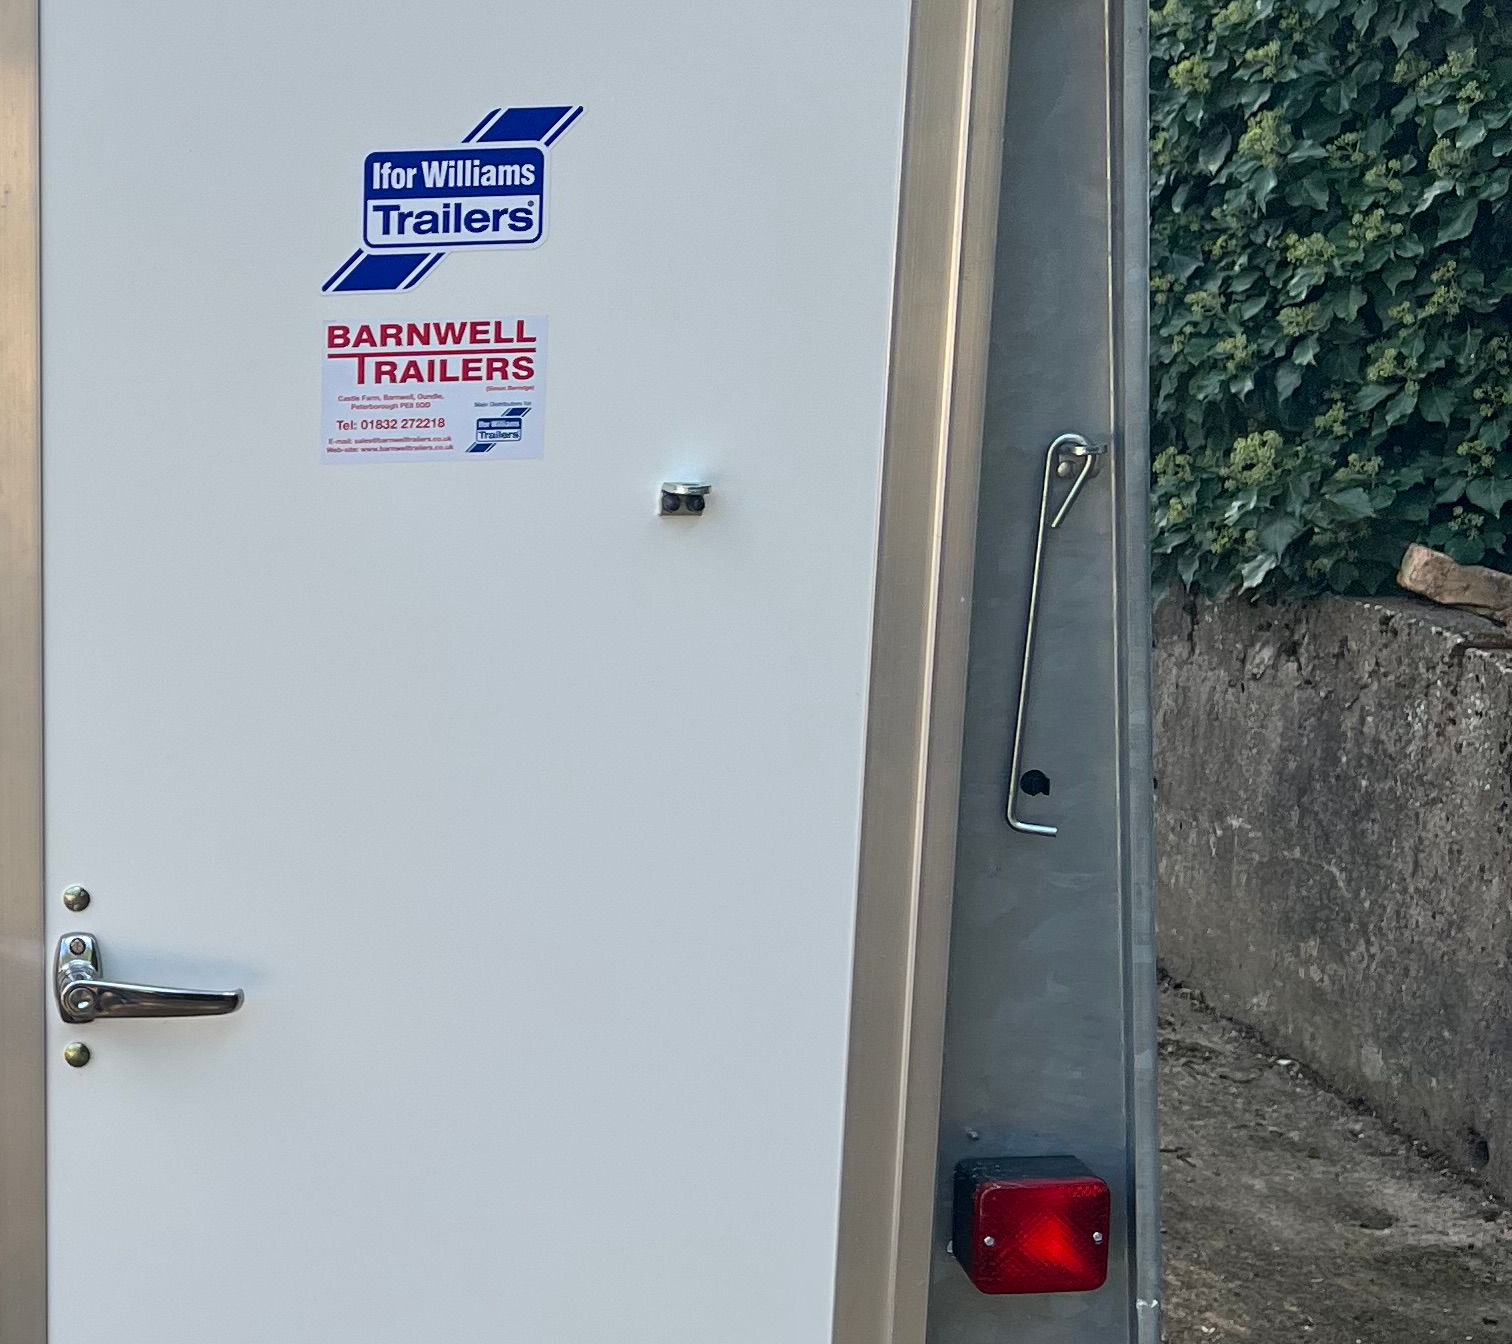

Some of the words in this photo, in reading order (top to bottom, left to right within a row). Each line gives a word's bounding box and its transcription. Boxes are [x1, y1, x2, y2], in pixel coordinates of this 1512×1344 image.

[372, 162, 417, 190] Ifor
[420, 160, 536, 189] Williams
[372, 202, 535, 236] Trailers
[327, 320, 536, 348] BARNWELL
[355, 355, 535, 385] TRAILERS
[351, 402, 398, 410] Peterborough
[336, 420, 357, 431] Tel:
[361, 419, 397, 430] 01832
[401, 418, 445, 429] 272218
[479, 430, 519, 439] Trailers
